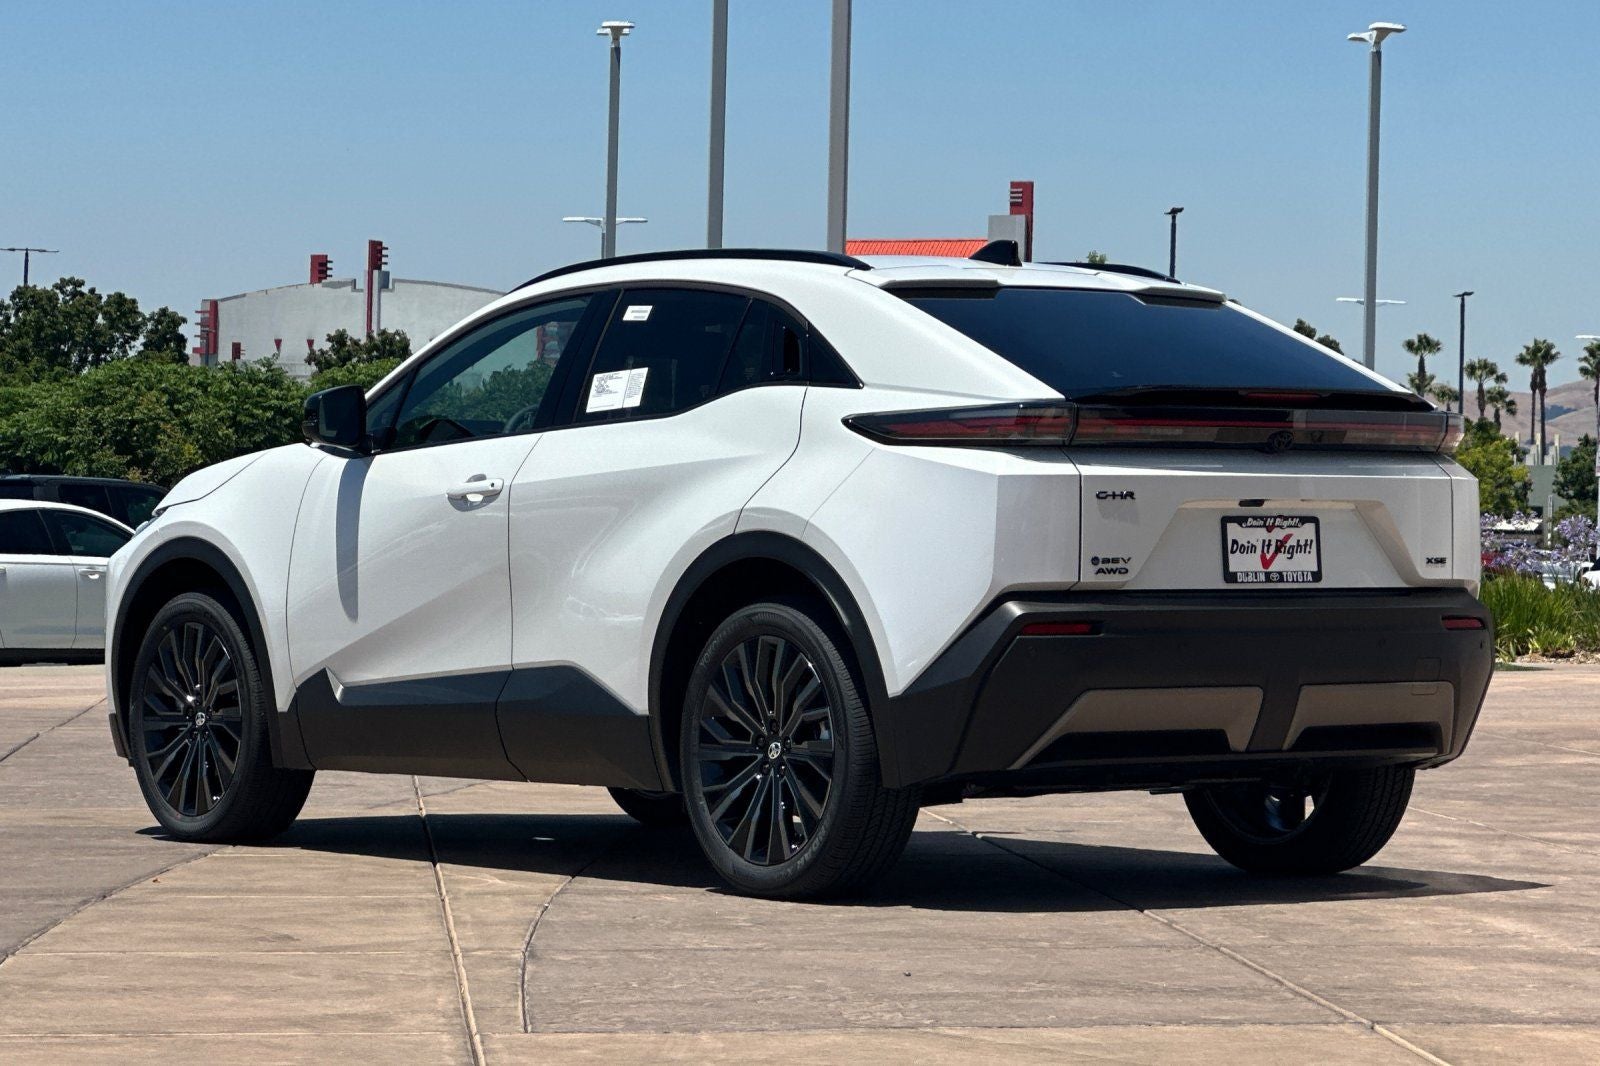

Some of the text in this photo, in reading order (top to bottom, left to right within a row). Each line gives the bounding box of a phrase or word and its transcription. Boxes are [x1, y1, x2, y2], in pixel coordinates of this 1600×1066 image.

[1230, 538, 1314, 560] Doin' It Right!
[1095, 567, 1129, 575] AWD
[1237, 571, 1313, 582] DUBLIN TOYOTA
